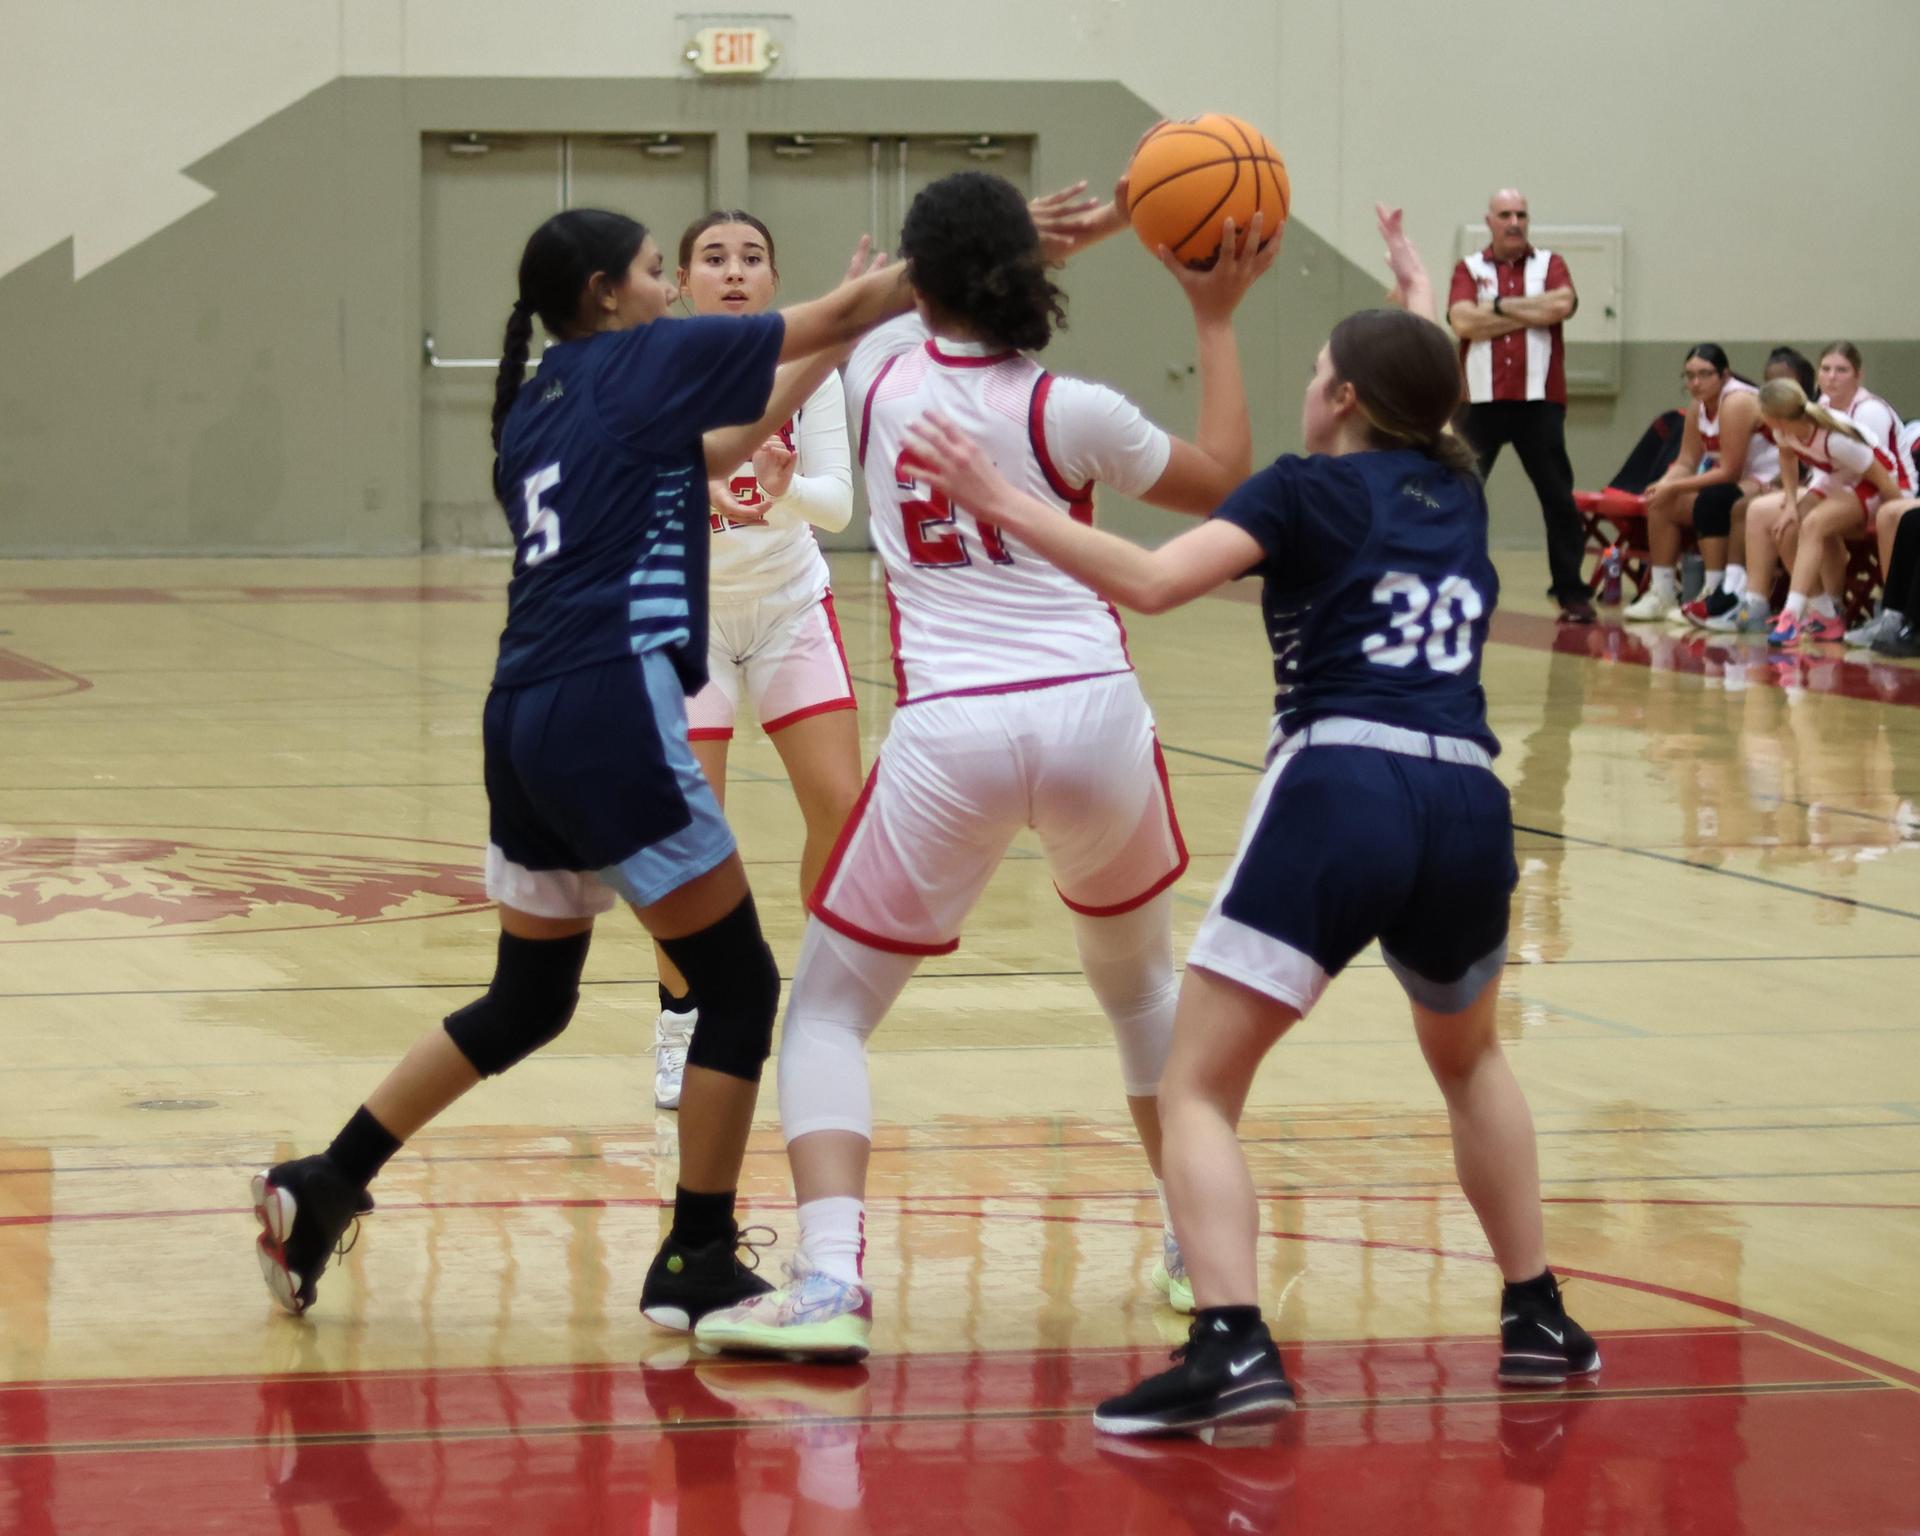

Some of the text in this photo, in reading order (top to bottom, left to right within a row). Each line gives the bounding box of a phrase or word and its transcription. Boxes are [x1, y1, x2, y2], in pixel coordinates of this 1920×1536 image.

[715, 32, 755, 64] EXIT
[523, 461, 561, 566] 5
[1361, 571, 1482, 674] 30
